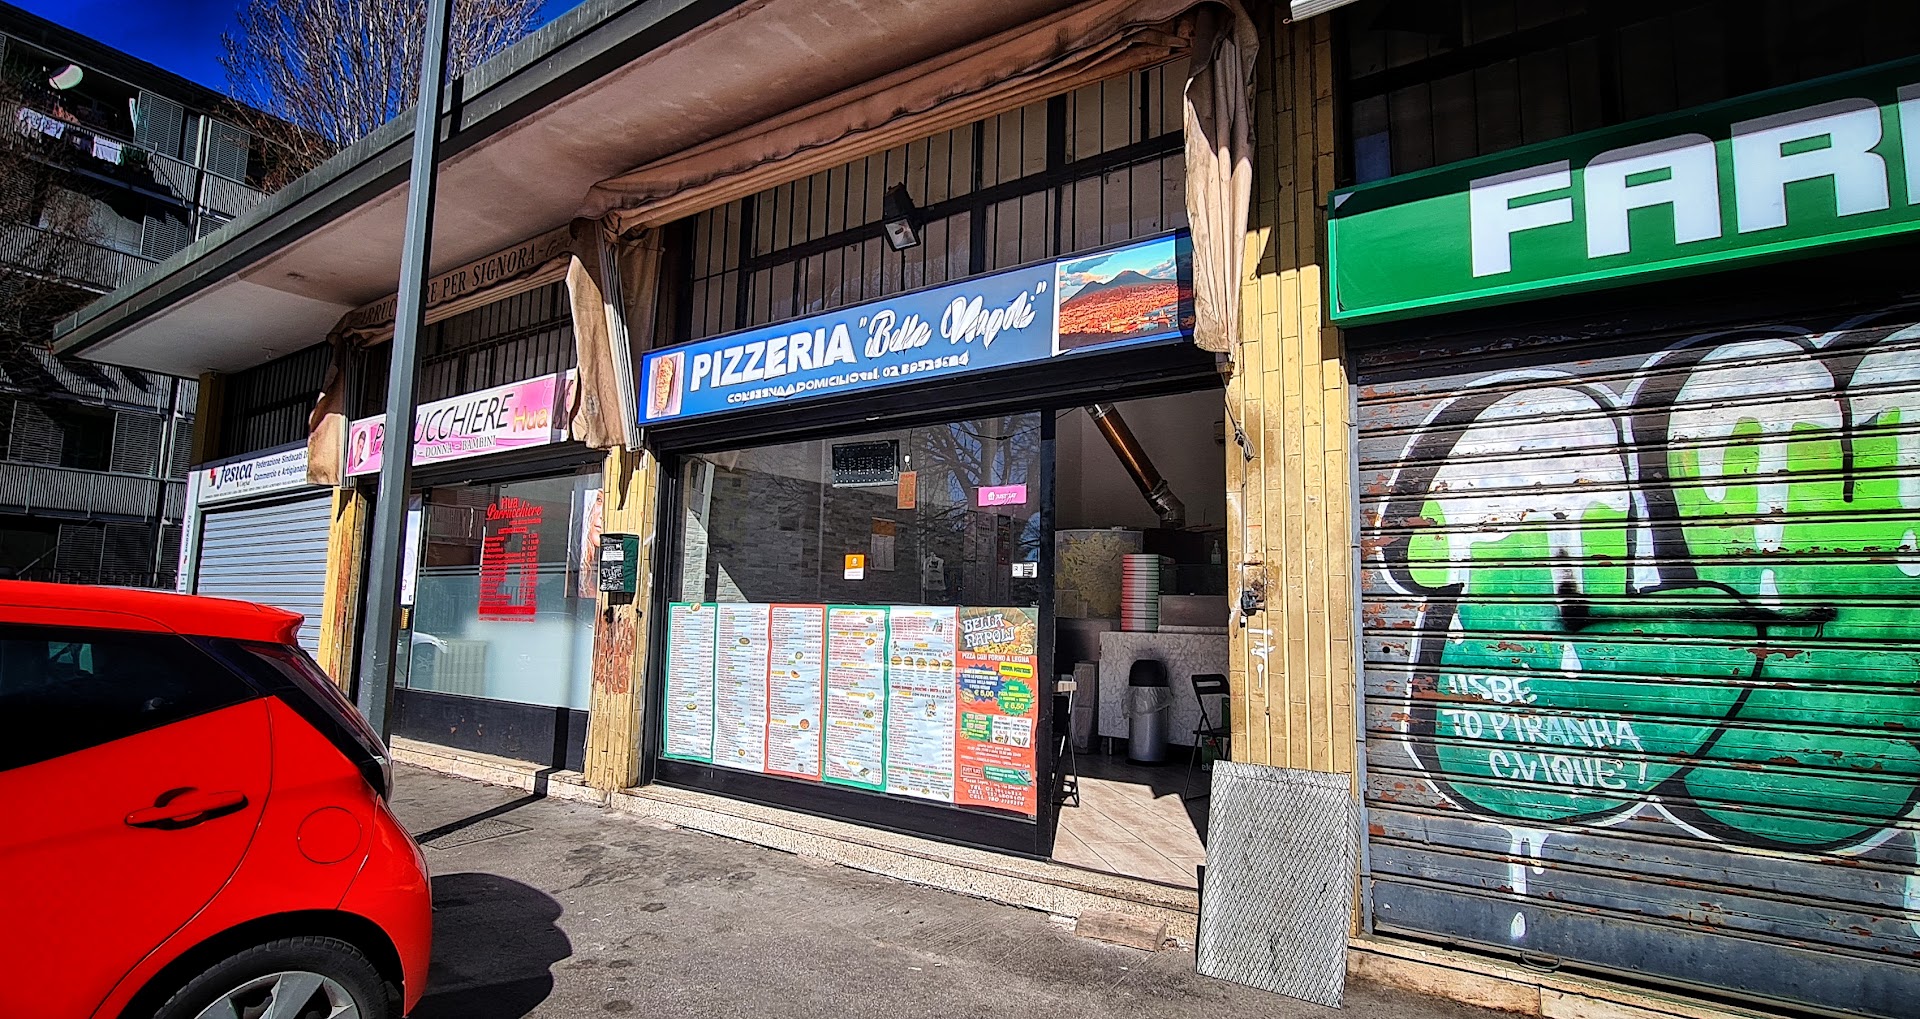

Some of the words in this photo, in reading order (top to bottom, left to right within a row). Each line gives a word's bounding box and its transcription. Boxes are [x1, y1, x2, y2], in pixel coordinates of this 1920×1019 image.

[1469, 84, 1920, 278] FAR
[442, 271, 467, 298] PER
[472, 242, 535, 287] SIGNORA
[690, 323, 858, 392] PIZZERIA
[513, 405, 548, 433] Hua
[425, 443, 452, 459] DONNA
[462, 435, 497, 451] BAMBINI
[256, 457, 281, 469] Federazione
[281, 450, 303, 464] Sindacati
[254, 470, 277, 482] Commercio
[486, 501, 543, 520] Parrucchiere
[501, 496, 519, 509] Hua
[963, 613, 1004, 634] BELLA
[964, 626, 1015, 648] NAPOLI
[962, 652, 976, 660] PIZZA
[988, 654, 1005, 662] FORNO
[1442, 709, 1482, 738] TO
[1490, 712, 1644, 752] PIRANHA
